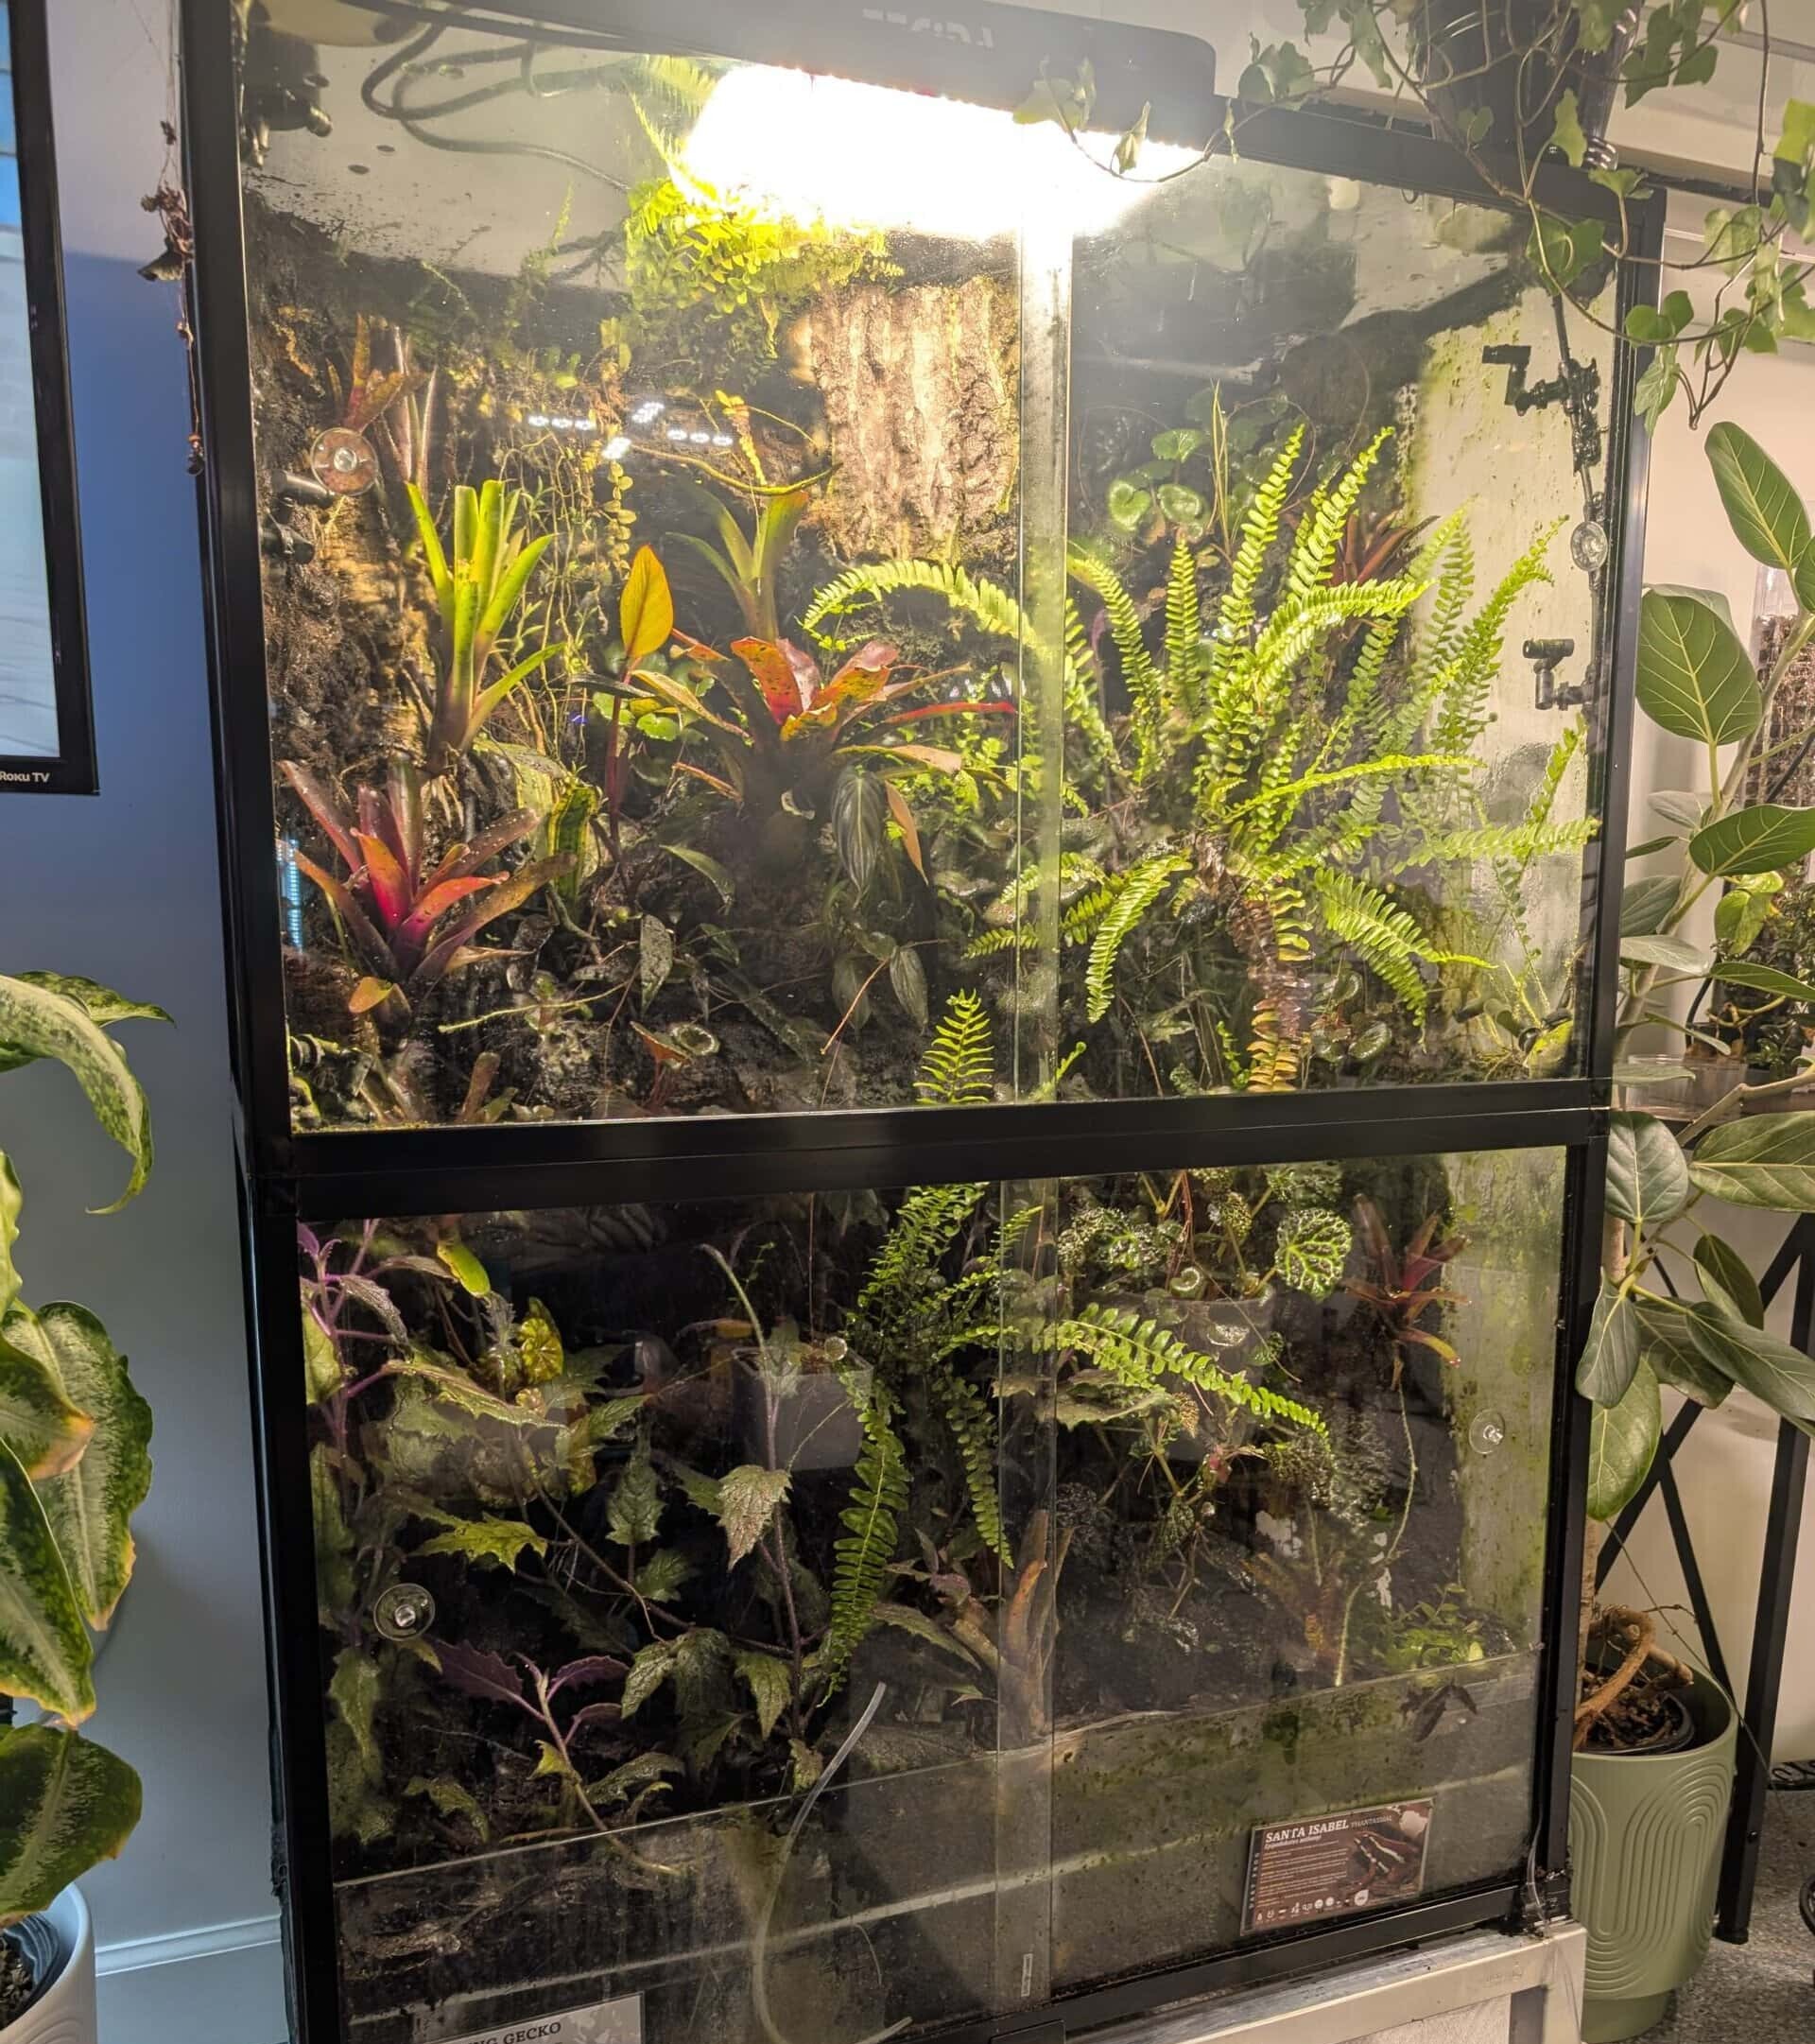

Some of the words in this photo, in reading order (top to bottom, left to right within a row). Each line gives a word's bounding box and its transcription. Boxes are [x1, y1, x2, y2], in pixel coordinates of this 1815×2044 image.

[0, 771, 30, 782] Roku
[31, 771, 50, 783] TV
[1265, 1827, 1305, 1843] SANTA
[1308, 1819, 1349, 1835] ISABEL
[503, 2022, 562, 2044] GECKO
